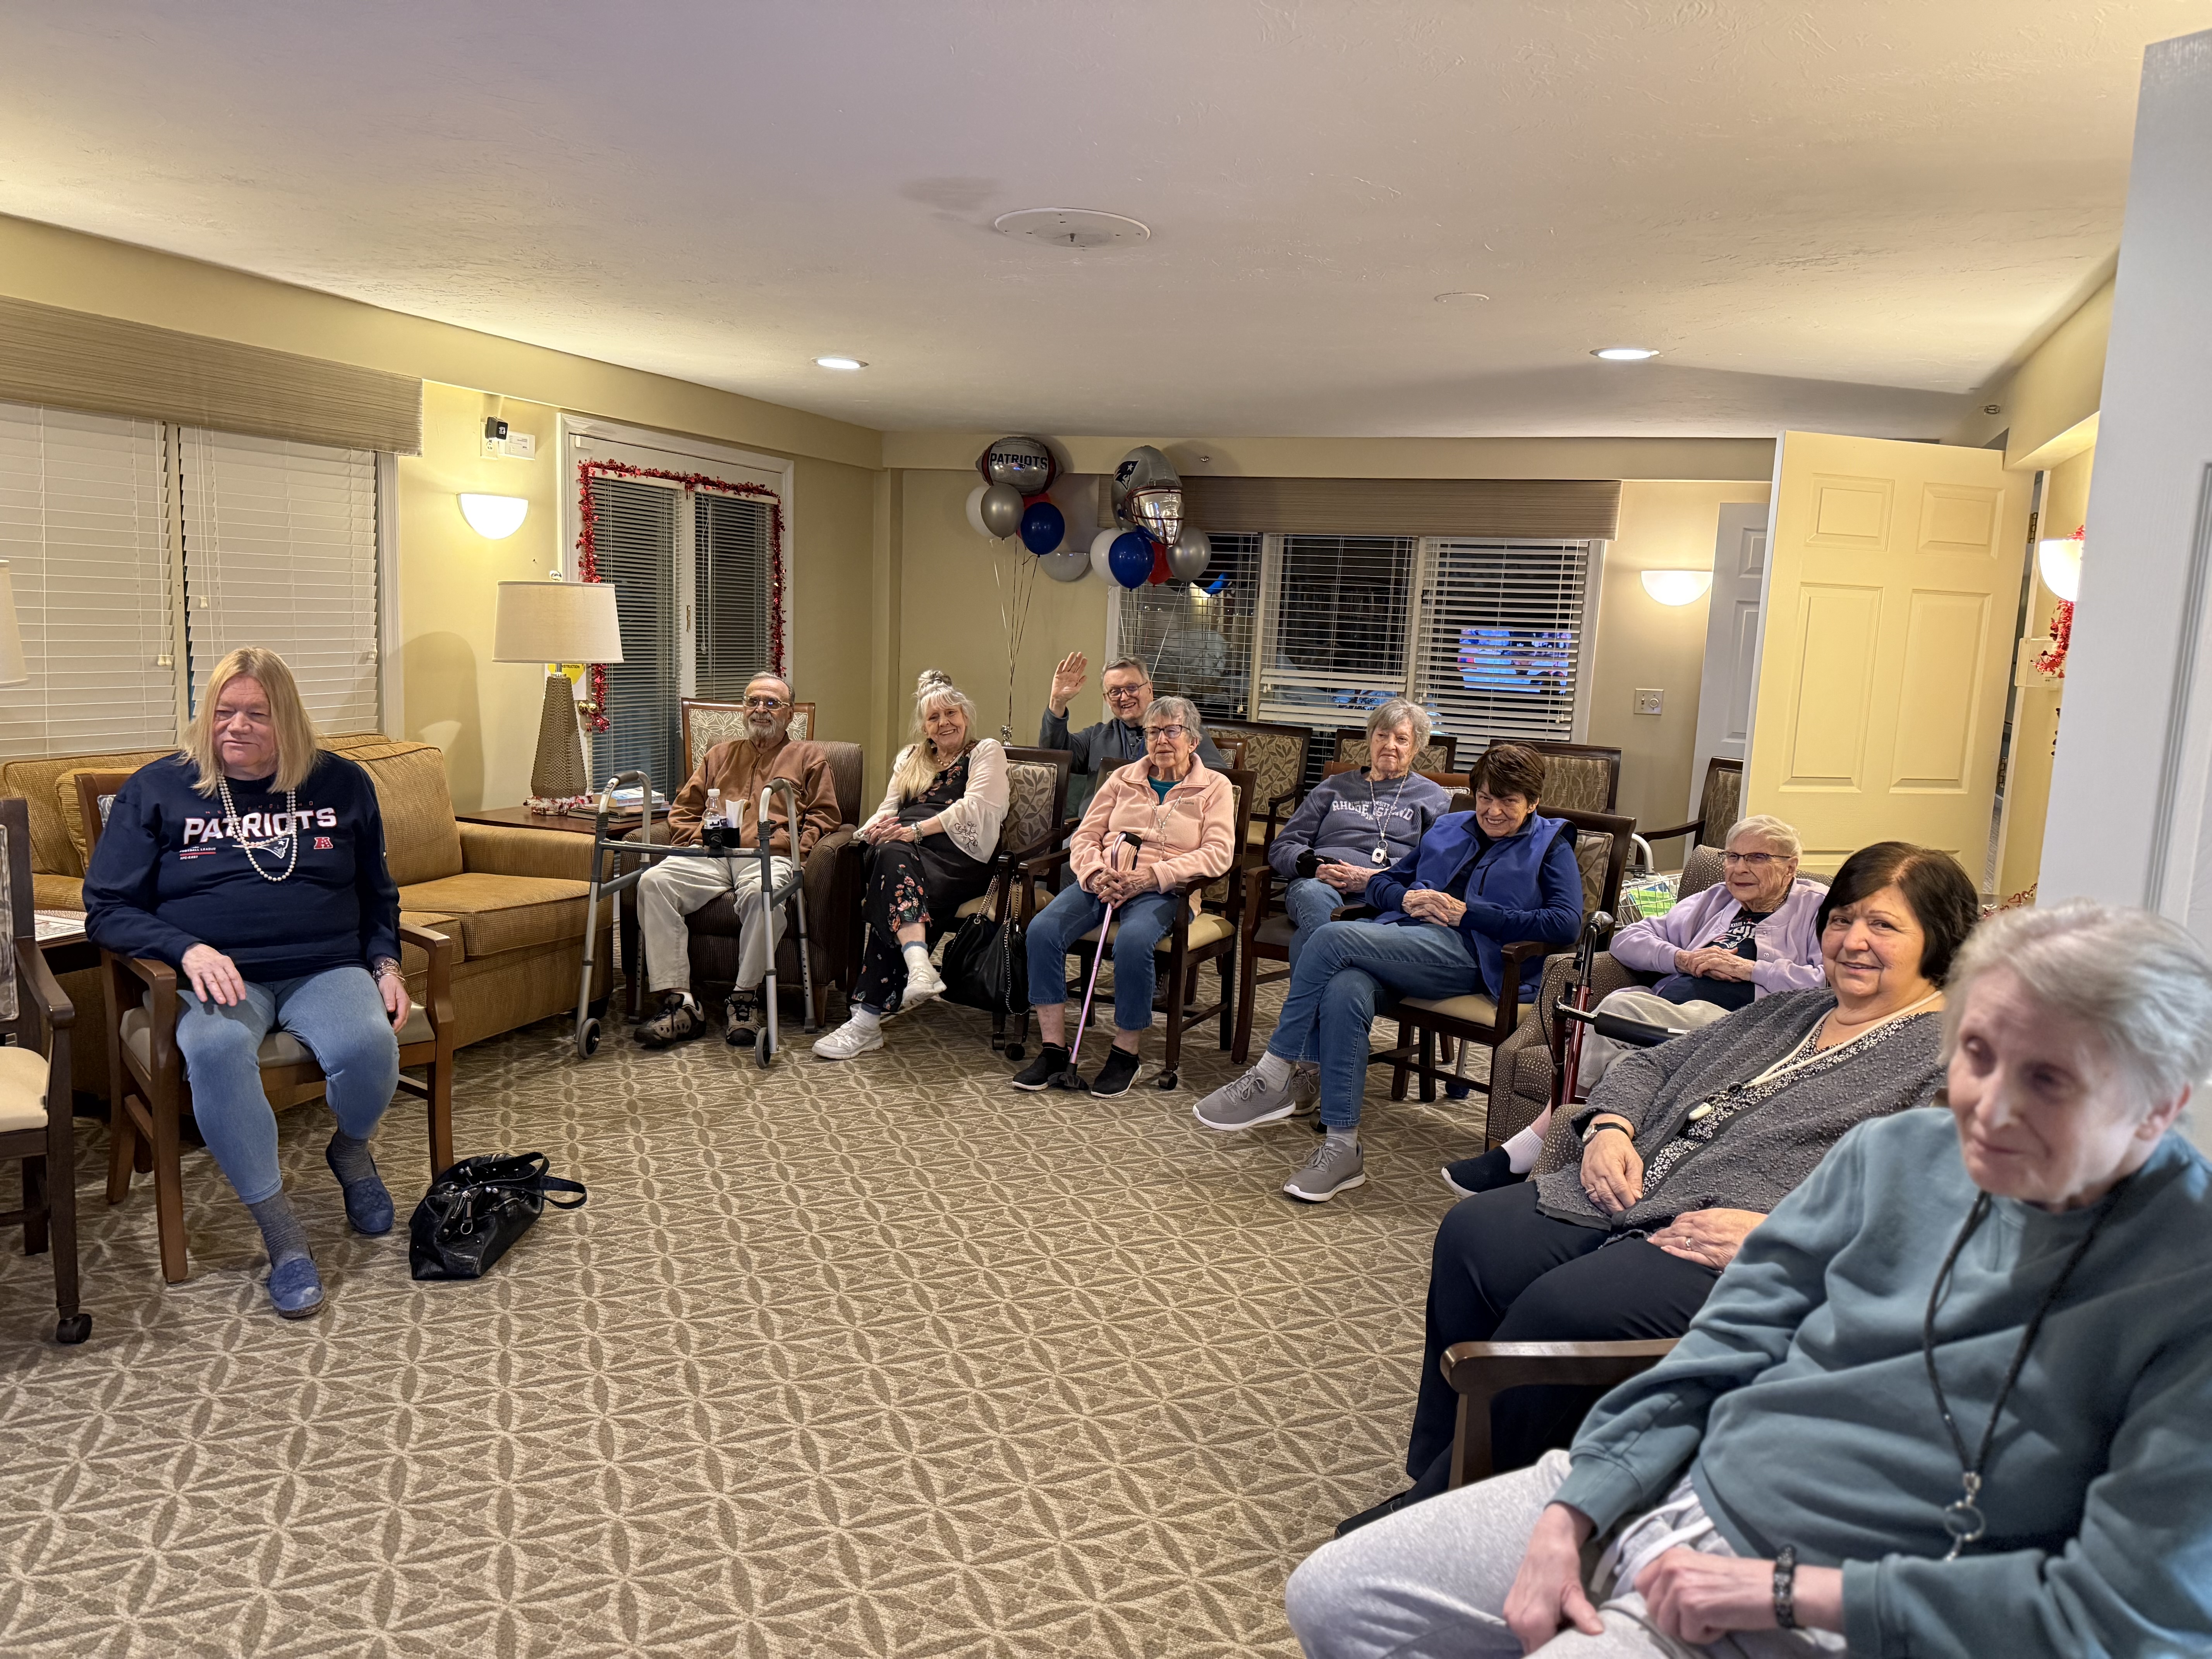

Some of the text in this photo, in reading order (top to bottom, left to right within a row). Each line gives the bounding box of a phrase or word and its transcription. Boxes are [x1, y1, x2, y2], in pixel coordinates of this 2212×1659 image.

[990, 453, 1048, 470] PATRIOTS
[1333, 801, 1369, 814] RHODE
[184, 808, 337, 845] PATRIOTS
